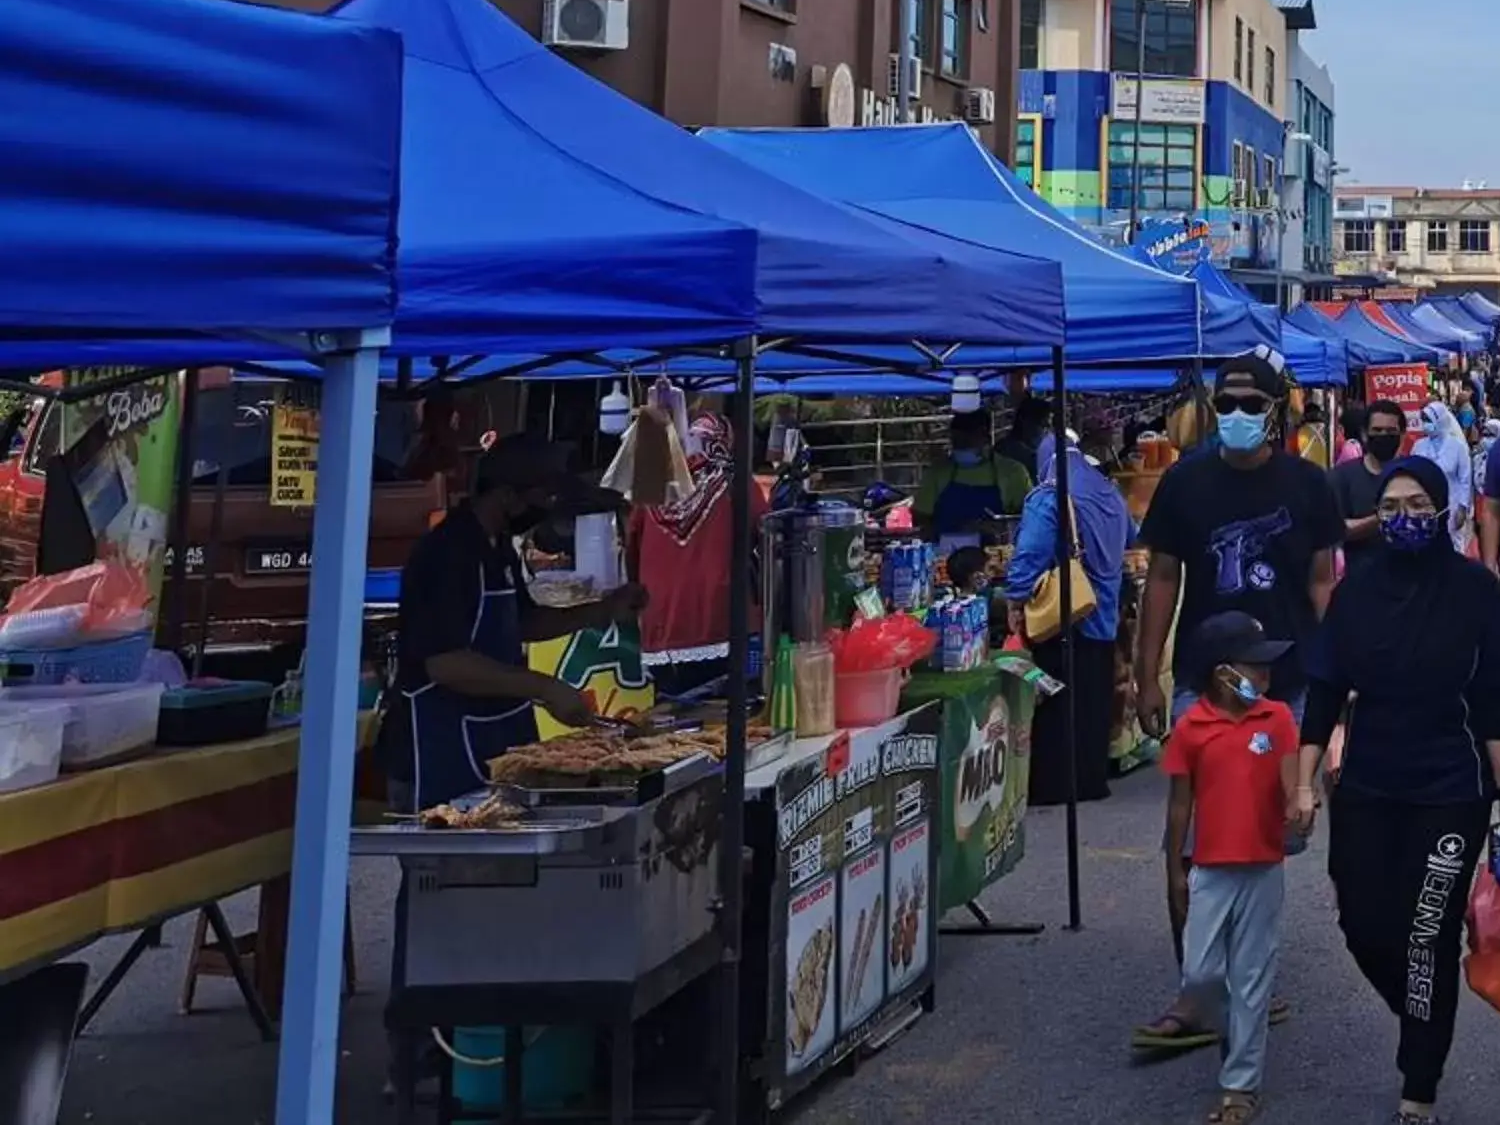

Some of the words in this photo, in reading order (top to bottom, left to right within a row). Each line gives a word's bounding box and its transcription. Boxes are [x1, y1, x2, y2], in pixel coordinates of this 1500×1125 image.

[1373, 370, 1423, 389] Popia
[107, 390, 164, 437] Boba
[261, 553, 291, 568] WGD
[882, 739, 938, 774] CHICKEN
[960, 738, 1007, 805] MILO
[1405, 871, 1456, 1023] CONVERSE
